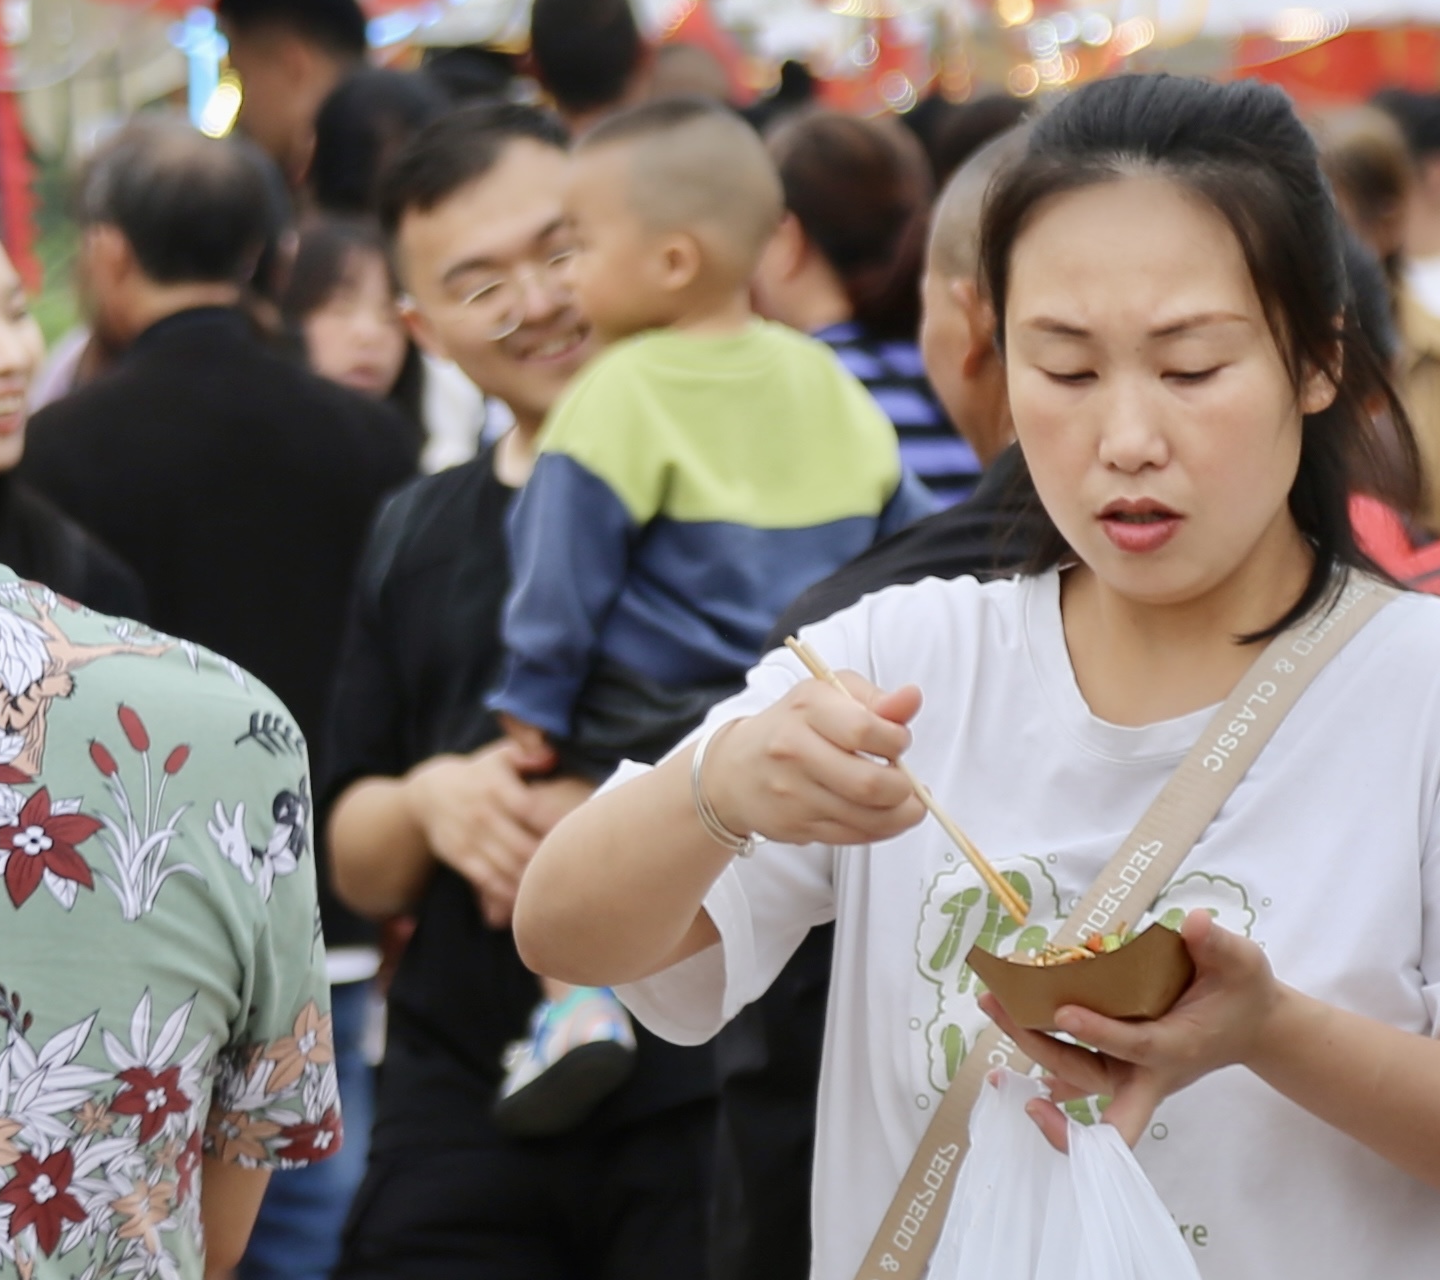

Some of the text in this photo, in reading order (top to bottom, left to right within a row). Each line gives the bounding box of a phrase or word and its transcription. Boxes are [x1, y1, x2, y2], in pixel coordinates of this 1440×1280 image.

[1272, 658, 1296, 674] &
[1203, 680, 1277, 772] CLASSIC
[879, 1253, 900, 1272] &
